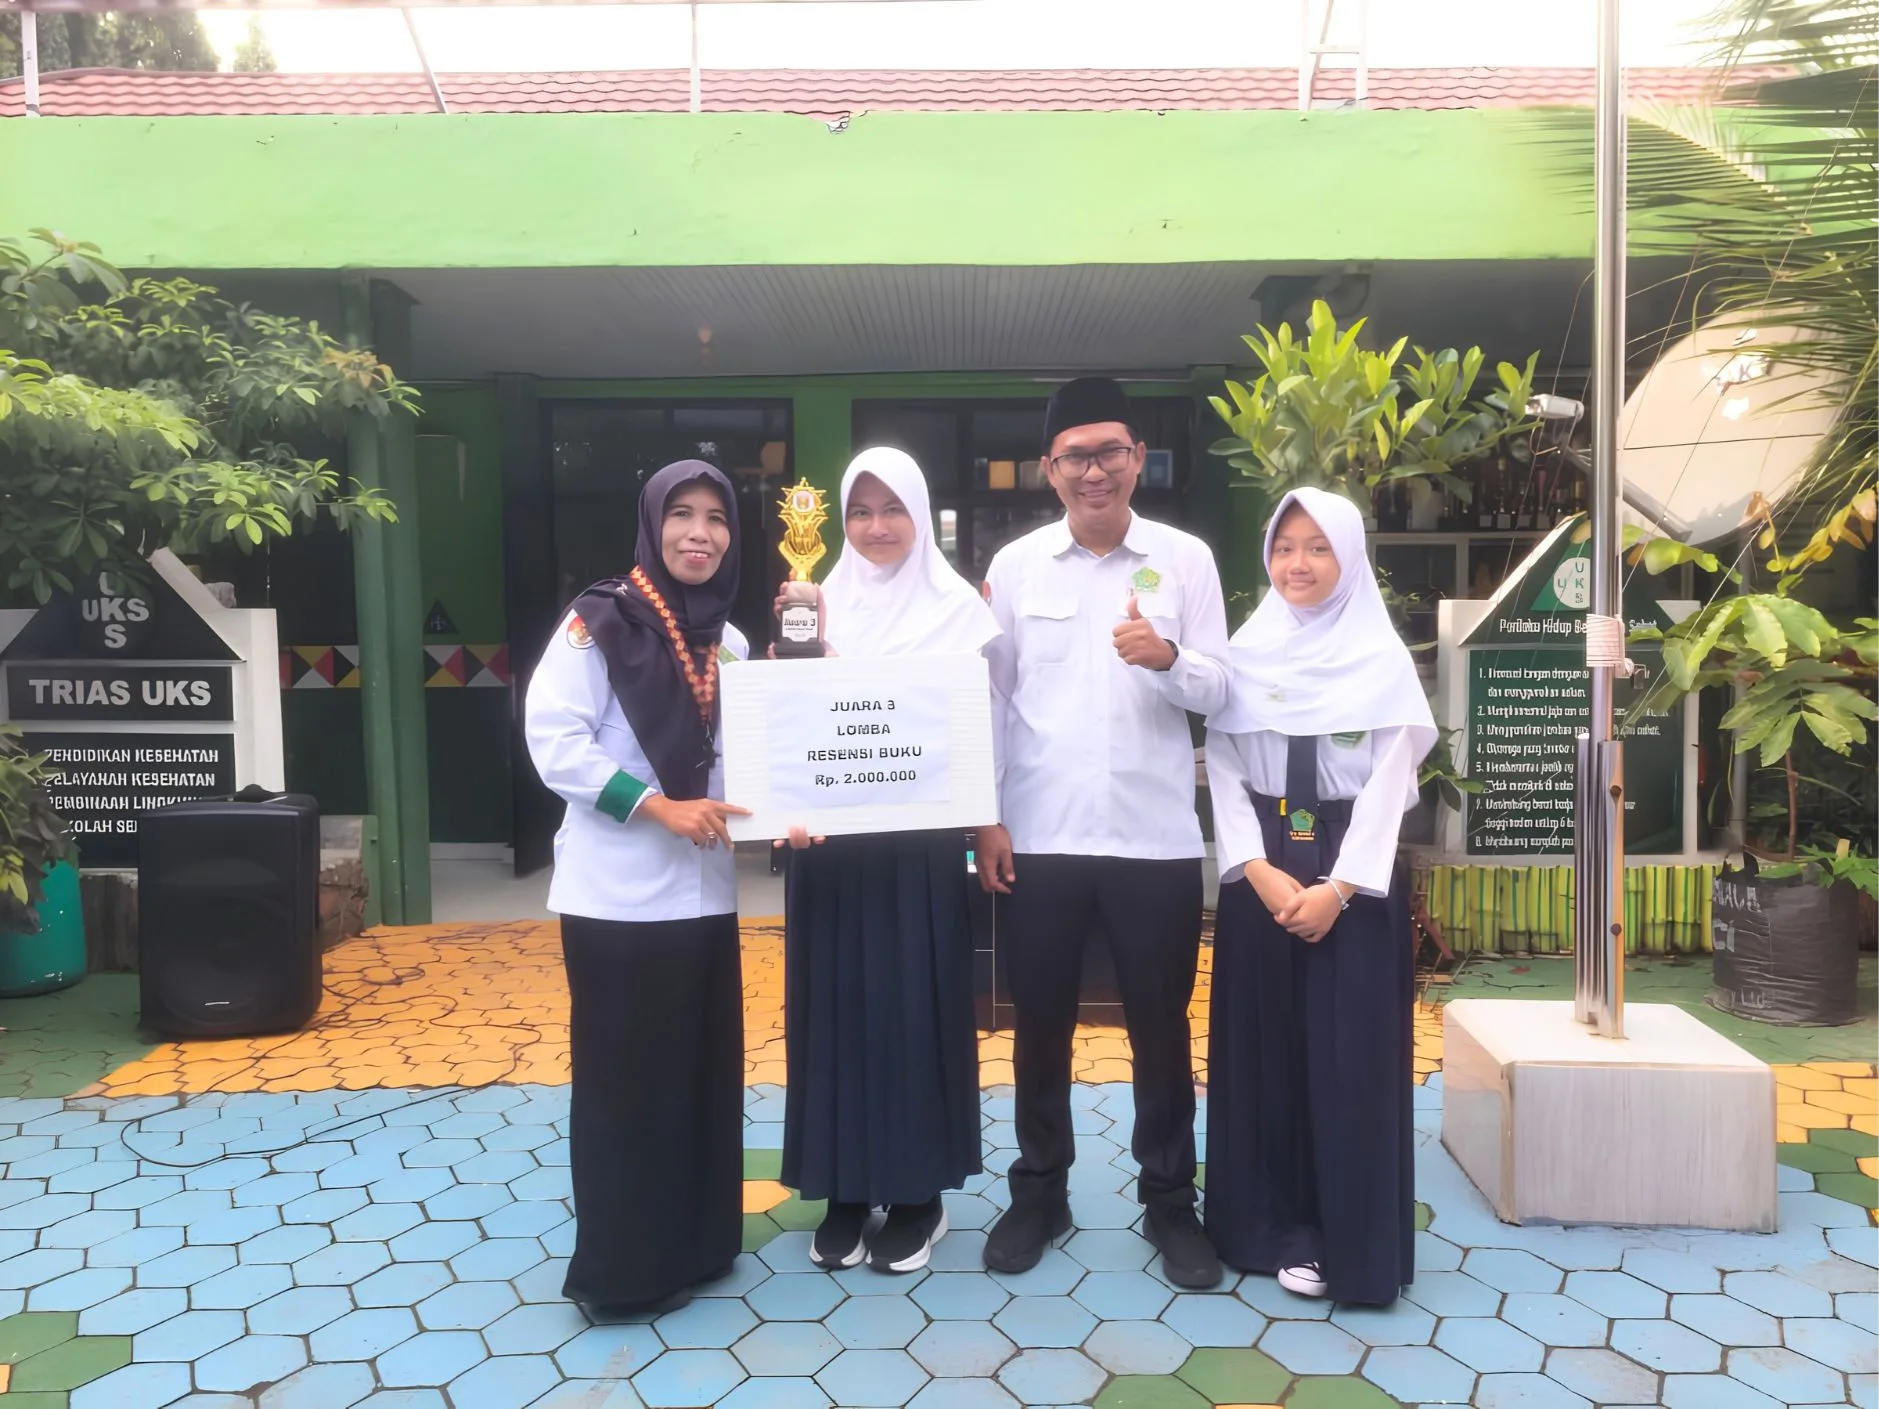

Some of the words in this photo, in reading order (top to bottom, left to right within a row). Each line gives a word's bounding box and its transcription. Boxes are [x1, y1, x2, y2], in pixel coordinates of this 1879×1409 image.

[28, 680, 131, 705] TRIAS
[142, 680, 212, 706] UKS
[830, 700, 882, 712] JUARA
[887, 700, 895, 710] 3
[837, 724, 891, 736] LOMBA
[135, 749, 218, 763] KESEHATAN
[807, 747, 873, 762] RESENSI
[879, 746, 922, 758] BUKU
[132, 773, 215, 787] KESEHATAN
[844, 770, 916, 784] 2.000.000
[49, 796, 129, 810] EMBINAAN
